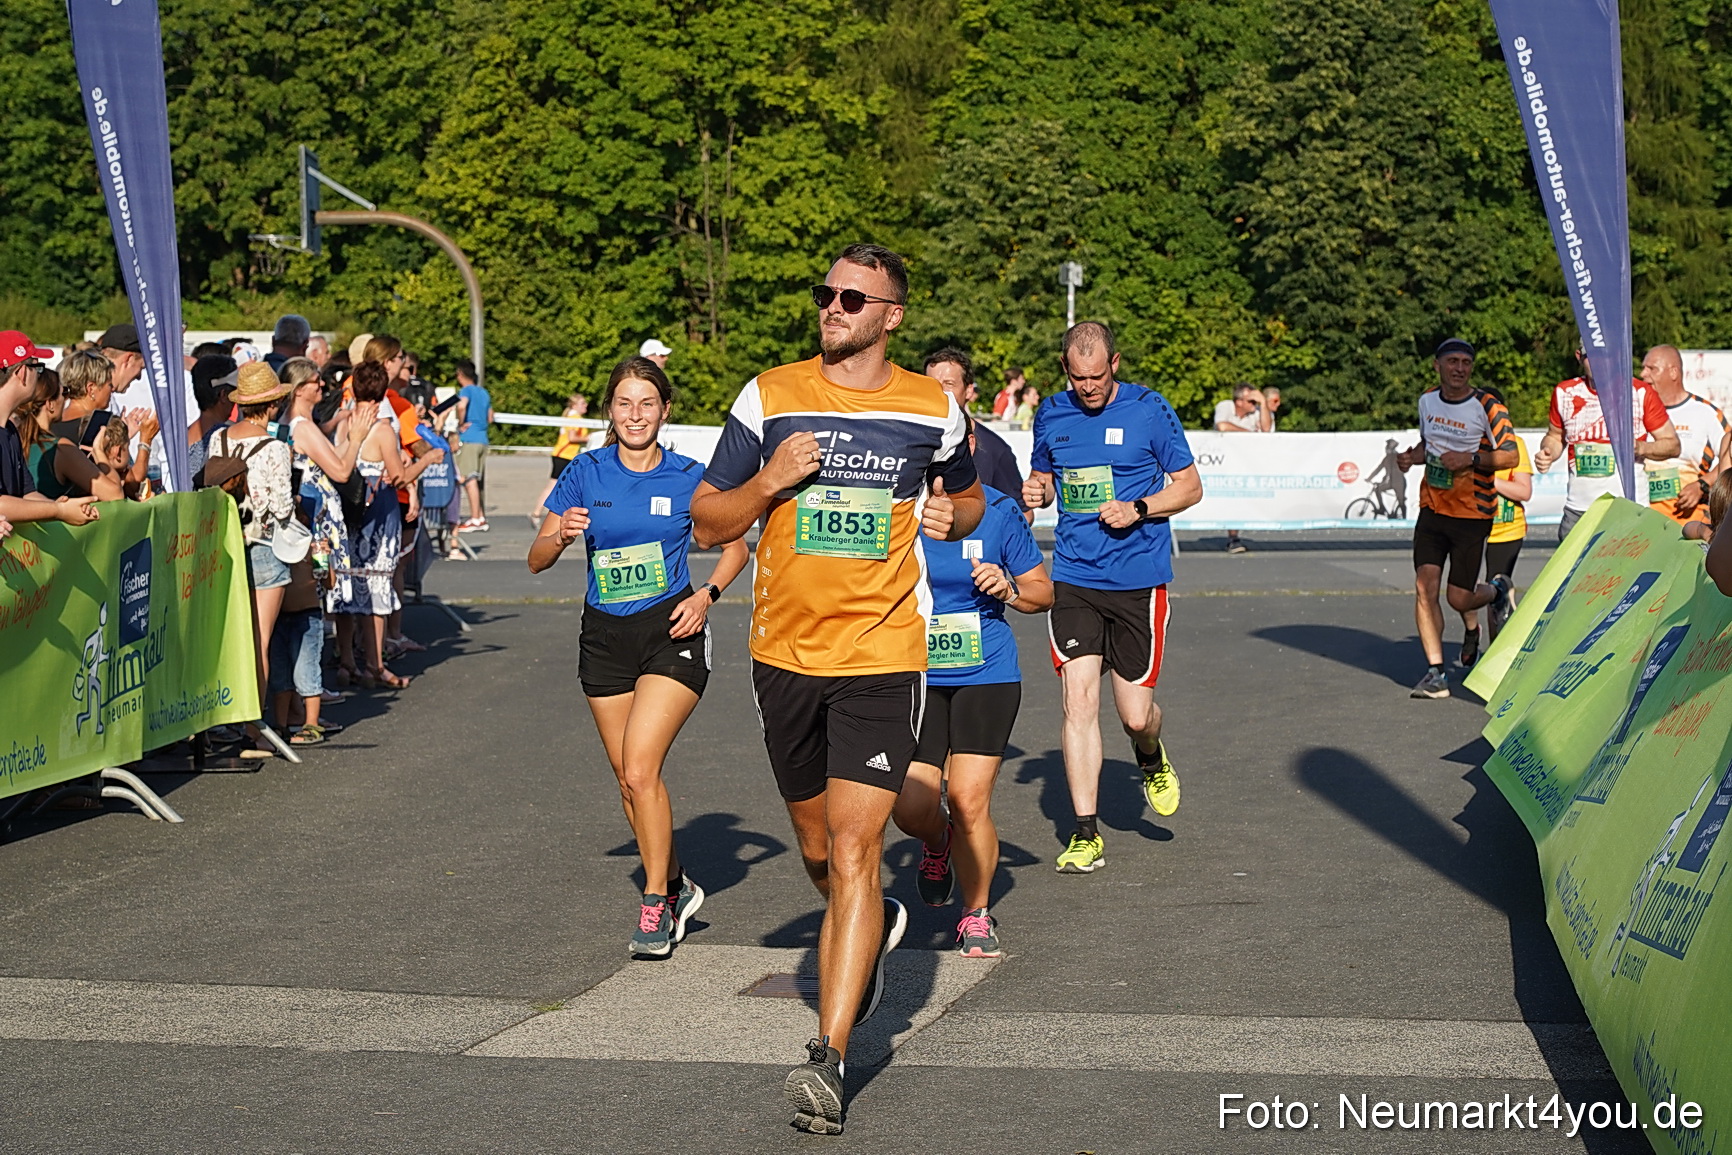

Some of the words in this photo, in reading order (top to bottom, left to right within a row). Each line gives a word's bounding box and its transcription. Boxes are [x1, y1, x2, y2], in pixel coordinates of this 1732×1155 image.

[1580, 454, 1608, 467] 1131
[819, 469, 900, 482] AUTOMOBILE
[1069, 483, 1100, 499] 972
[593, 500, 613, 508] JAKO
[801, 516, 811, 541] RUN
[812, 510, 876, 536] 1853
[876, 517, 887, 550] 2022
[808, 534, 852, 545] Krauberger
[852, 536, 877, 545] Daniel
[610, 563, 647, 585] 970
[653, 563, 665, 588] 2022
[928, 632, 963, 652] 969
[970, 633, 980, 659] 2022
[106, 688, 145, 726] neumar
[866, 760, 892, 772] adidas
